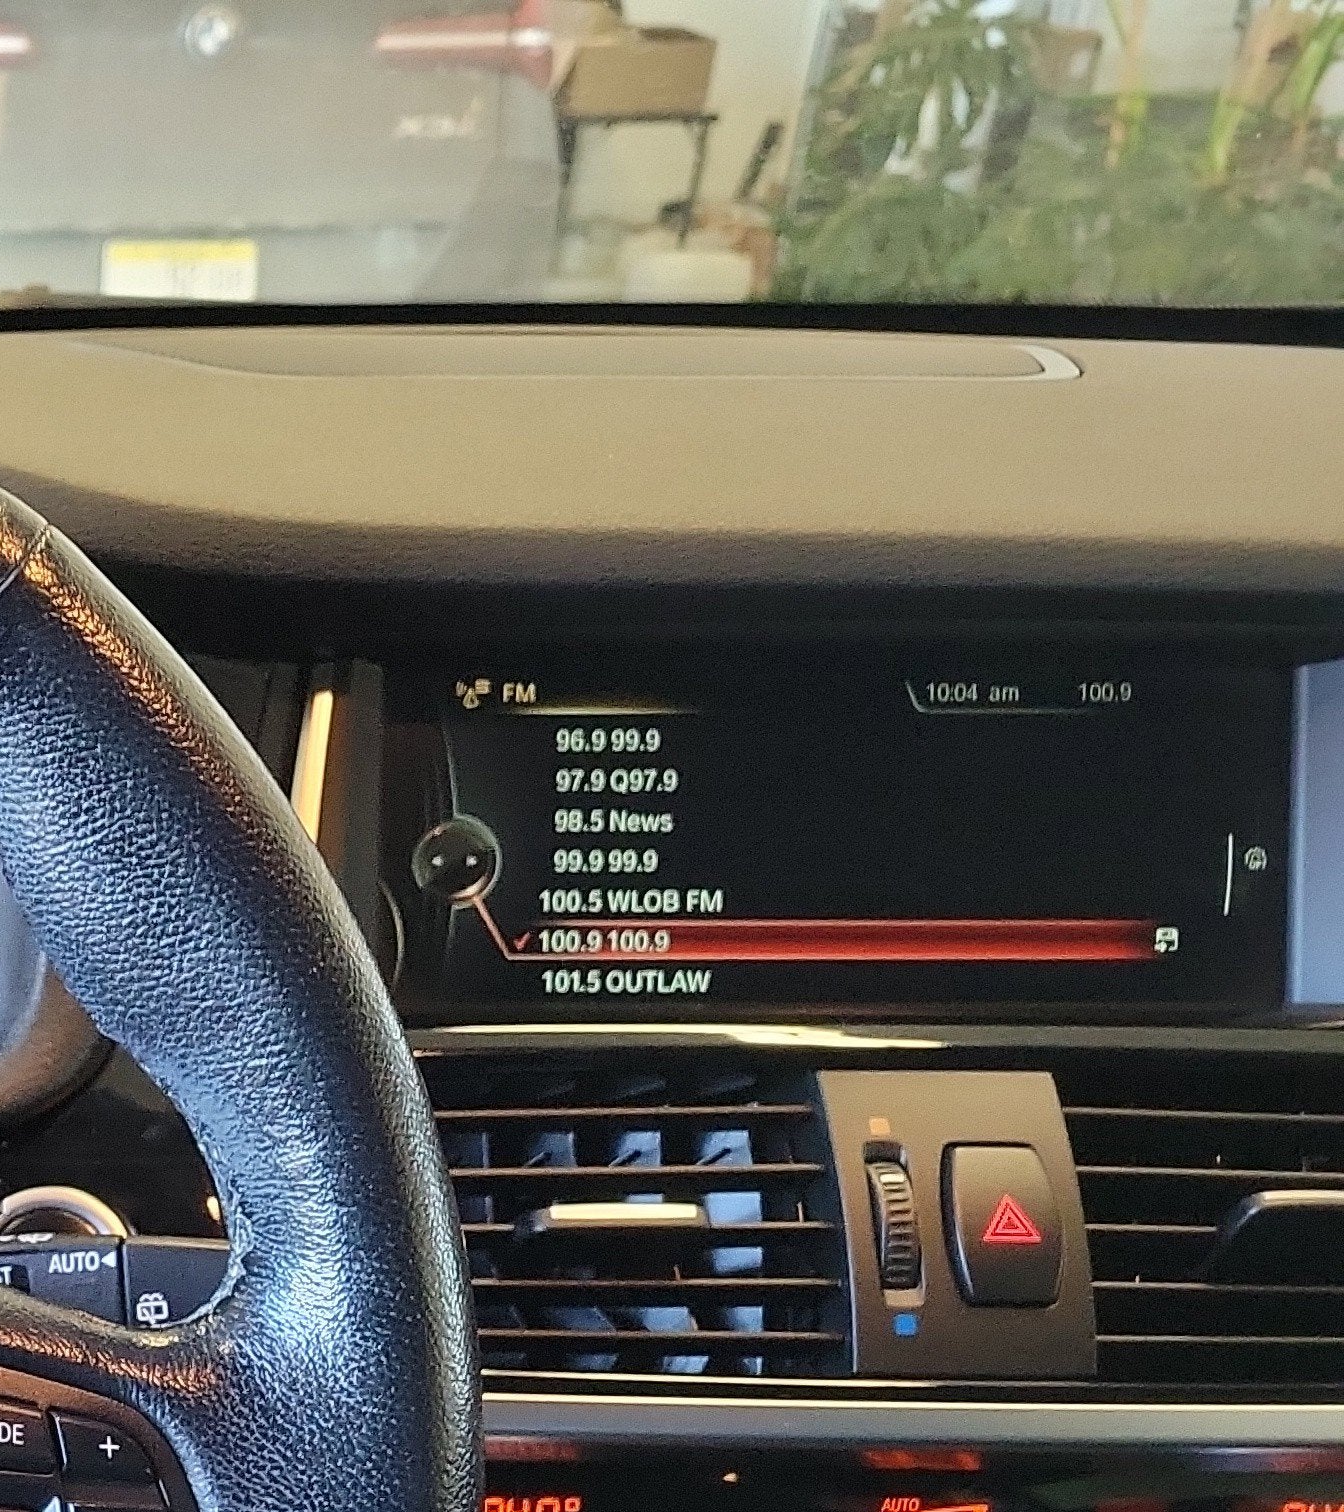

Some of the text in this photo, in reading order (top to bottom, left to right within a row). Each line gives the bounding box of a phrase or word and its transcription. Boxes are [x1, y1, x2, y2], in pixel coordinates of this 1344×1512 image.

[503, 683, 537, 703] FM
[926, 682, 1132, 702] 10:04 am 100.9
[556, 727, 661, 753] 96.9 99.9
[555, 768, 679, 795] 97.9 Q97.9
[554, 809, 673, 833] 98.5 News
[553, 849, 659, 874] 99.9 99.9
[539, 888, 724, 913] 100.5 WLOB FM
[538, 929, 671, 953] 100.9 100.9
[542, 969, 713, 994] 101.5 OUTLAW
[49, 1251, 100, 1274] AUTO
[881, 1497, 920, 1512] AUTO
